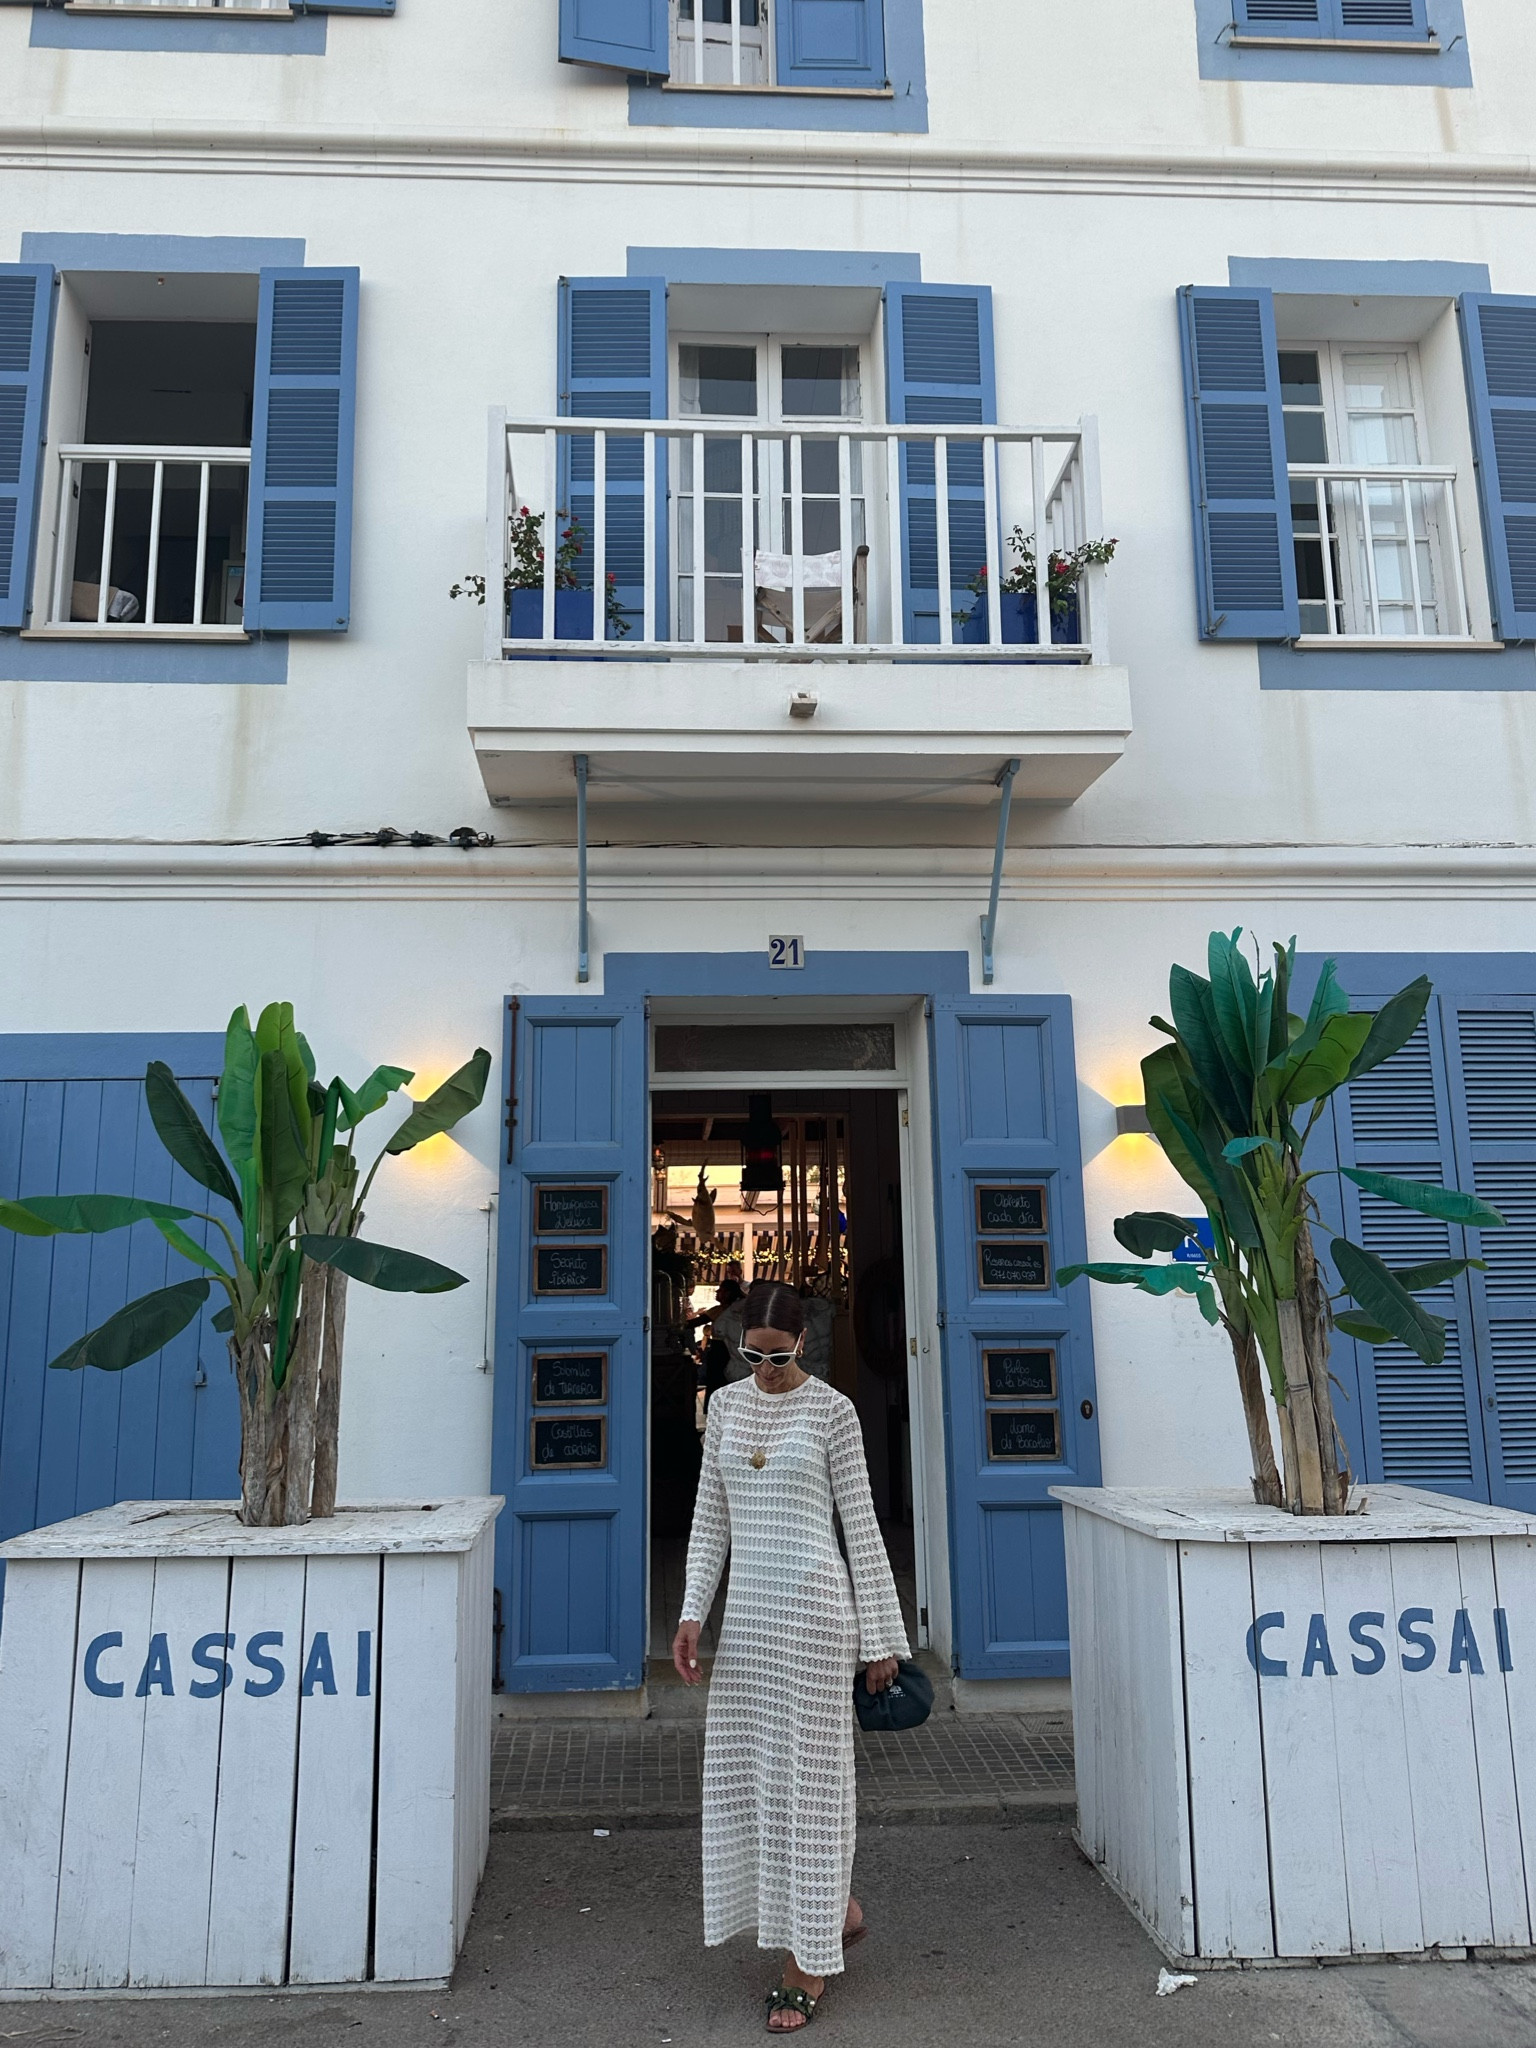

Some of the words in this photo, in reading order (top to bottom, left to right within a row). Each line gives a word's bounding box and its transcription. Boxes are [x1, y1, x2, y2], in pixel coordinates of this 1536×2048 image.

[770, 938, 799, 966] 21
[84, 1630, 371, 1699] CASSAI
[1246, 1607, 1514, 1677] CASSAI
